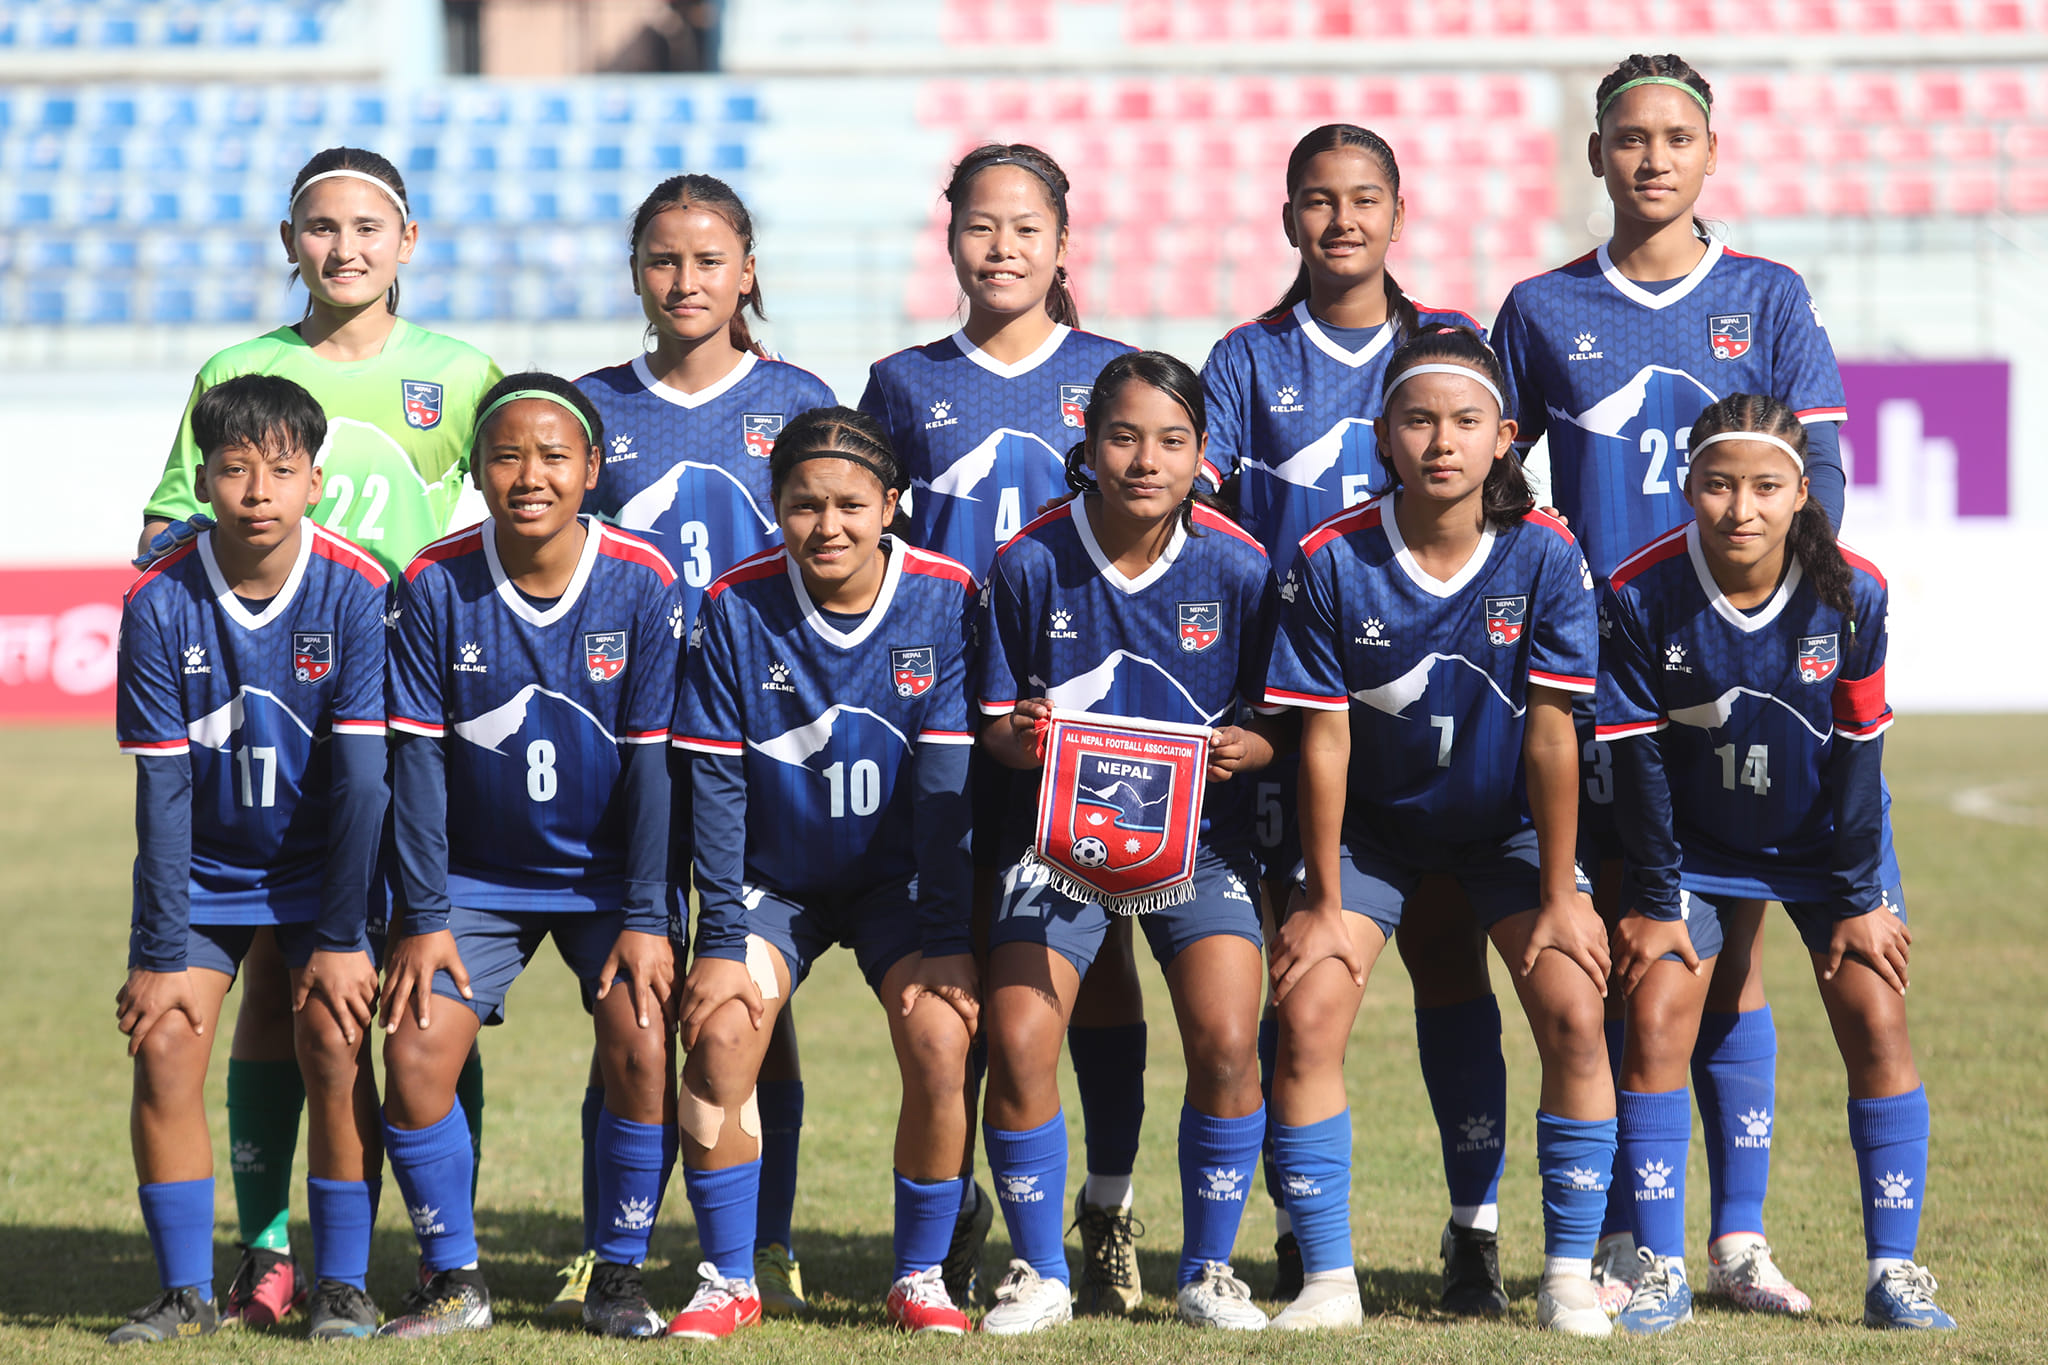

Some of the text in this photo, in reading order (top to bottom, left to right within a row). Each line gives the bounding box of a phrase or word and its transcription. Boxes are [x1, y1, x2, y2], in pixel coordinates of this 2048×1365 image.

[1568, 351, 1604, 361] KELME
[1270, 404, 1304, 413] KELME
[925, 417, 958, 430] KELME
[605, 452, 638, 464] KELME
[325, 474, 390, 539] 22
[994, 487, 1021, 541] 4
[680, 520, 712, 588] 3
[1355, 637, 1391, 647] KELME
[181, 666, 212, 674] ELME
[453, 663, 487, 673] KELME
[1663, 664, 1692, 673] ELME
[762, 682, 796, 693] KELME
[1065, 733, 1192, 758] ALL NEPAL FOOTBALL ASSOCIATION
[1430, 714, 1454, 768] 7
[236, 744, 277, 807] 17
[526, 739, 558, 802] 8
[1097, 760, 1152, 780] NEPAL
[1582, 739, 1615, 804] 3
[1714, 743, 1771, 796] 14
[822, 758, 880, 818] 10
[1256, 782, 1283, 848] 5
[1000, 1190, 1045, 1203] KELME
[1198, 1188, 1242, 1202] KELME
[1635, 1187, 1675, 1202] KELME
[1874, 1198, 1914, 1209] KELME
